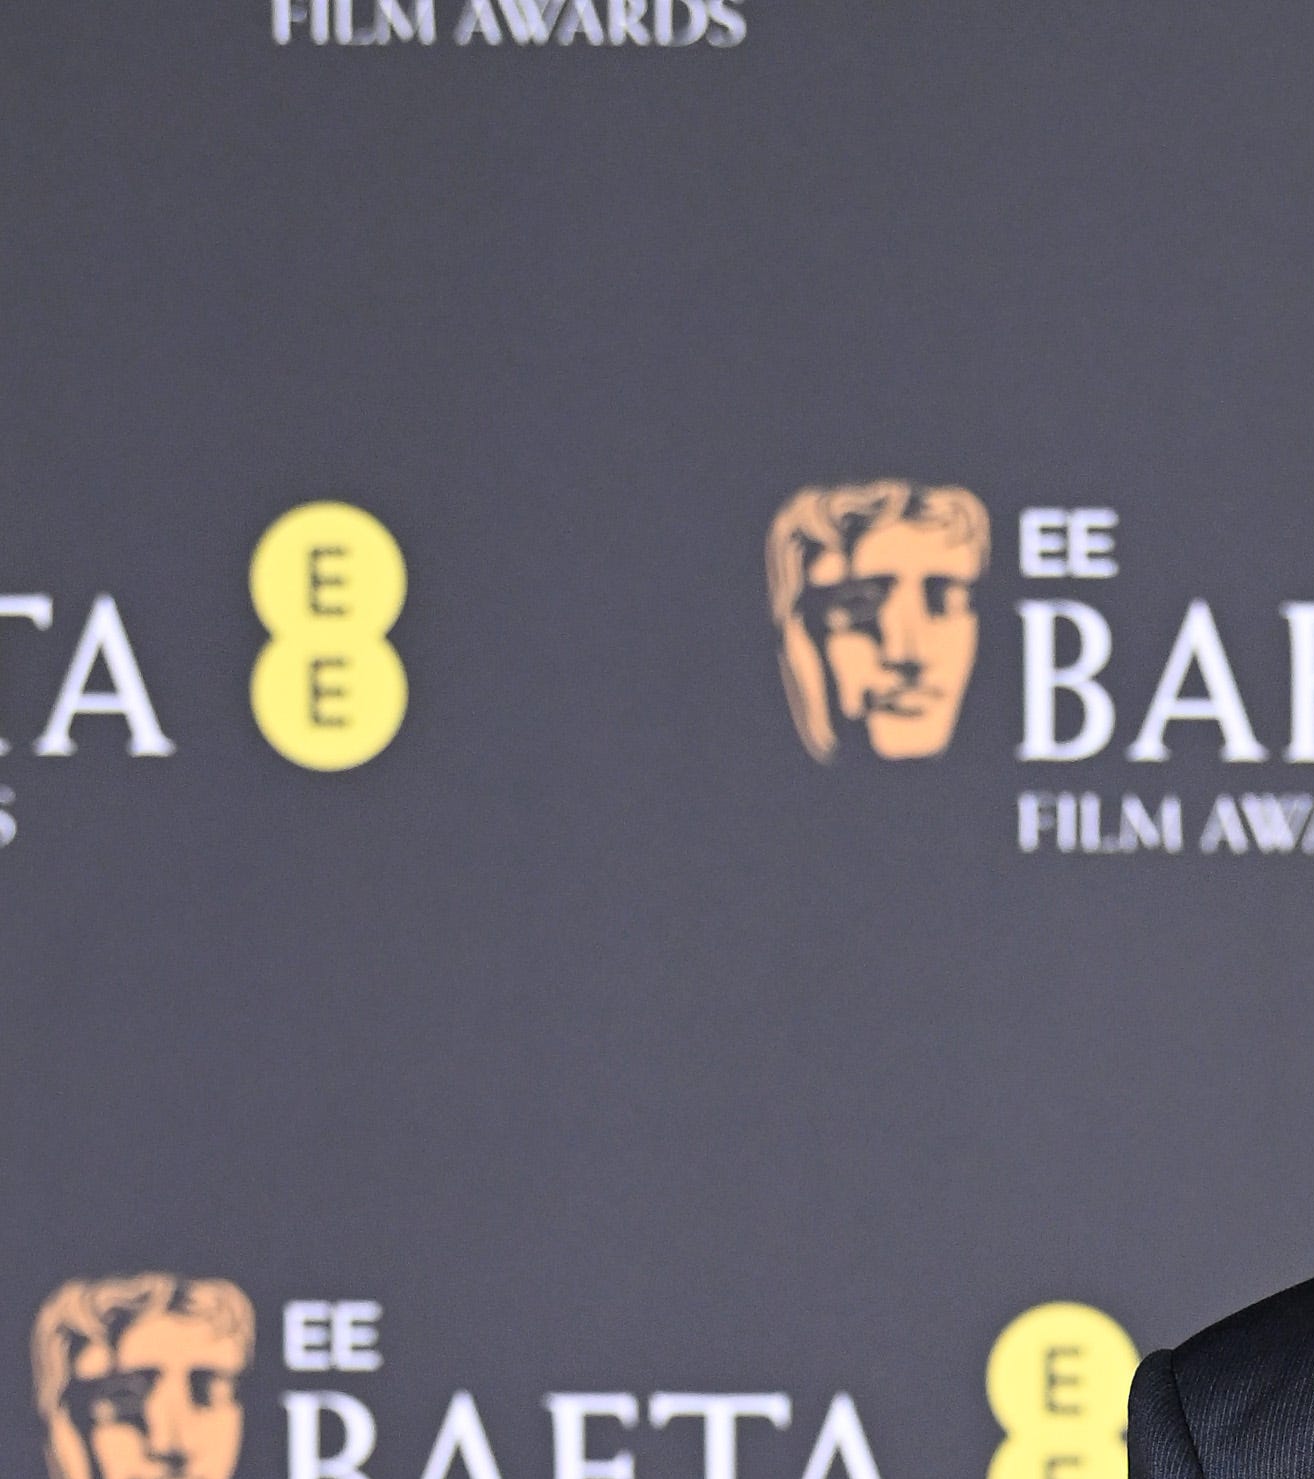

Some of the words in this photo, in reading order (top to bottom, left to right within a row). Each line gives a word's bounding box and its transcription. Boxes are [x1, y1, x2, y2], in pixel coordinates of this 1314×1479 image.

[272, 0, 436, 45] FILM
[457, 0, 746, 46] AWARDS
[1019, 508, 1118, 578] EE
[1018, 792, 1183, 853] FILM
[284, 1301, 381, 1371] EE
